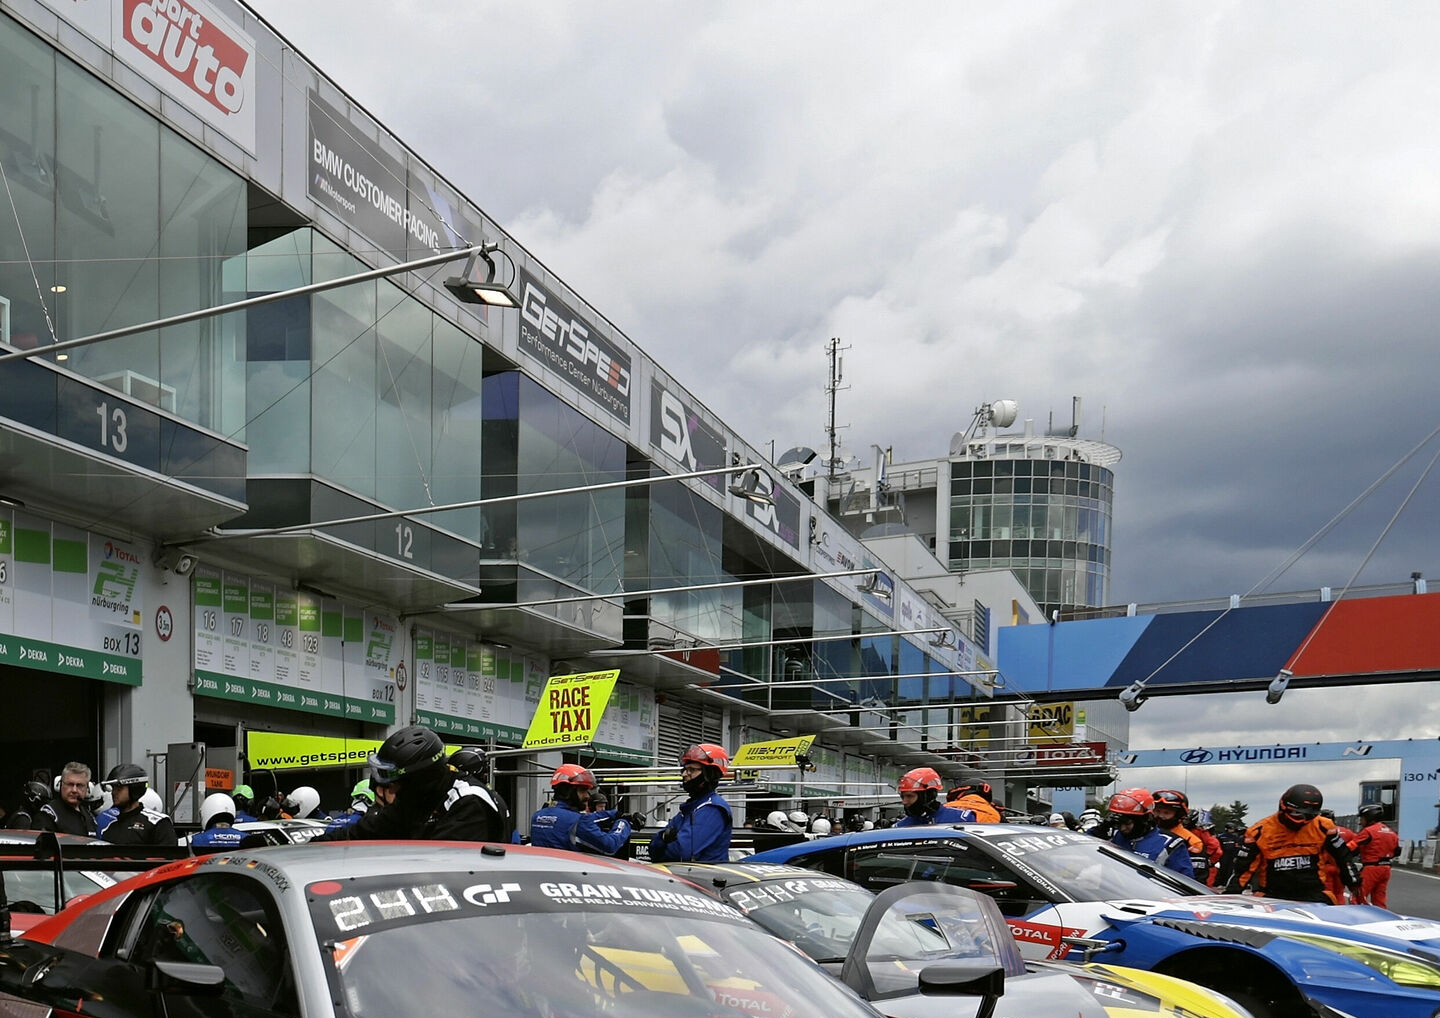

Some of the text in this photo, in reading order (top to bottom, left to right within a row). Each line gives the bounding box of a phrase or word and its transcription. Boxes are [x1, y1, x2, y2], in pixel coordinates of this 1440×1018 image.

[131, 3, 244, 113] auto
[313, 138, 343, 180] BMW
[344, 163, 402, 226] CUSTOMER
[521, 325, 629, 418] Performance Center Nürburgring
[96, 402, 128, 453] 13
[394, 522, 414, 560] 12
[115, 547, 140, 564] TOTAL
[91, 597, 129, 615] nürburgring
[203, 610, 216, 631] 16
[230, 617, 243, 636] 17
[103, 632, 140, 655] BOX 13
[256, 623, 269, 643] 18
[281, 628, 293, 649] 48
[303, 634, 319, 654] 123
[109, 663, 127, 676] DEKRA
[372, 685, 394, 702] BOX 12
[549, 686, 590, 710] RACE
[550, 708, 591, 734] TAXI
[1031, 705, 1071, 729] ADAC
[525, 733, 589, 746] under8.de
[1218, 747, 1307, 761] HYUNDAI
[1404, 772, 1424, 782] i30
[329, 884, 458, 932] 24H
[540, 882, 621, 900] GRAN
[622, 886, 744, 916] TURISMO
[624, 899, 679, 911] DRIVING
[1008, 923, 1053, 942] TOTAL
